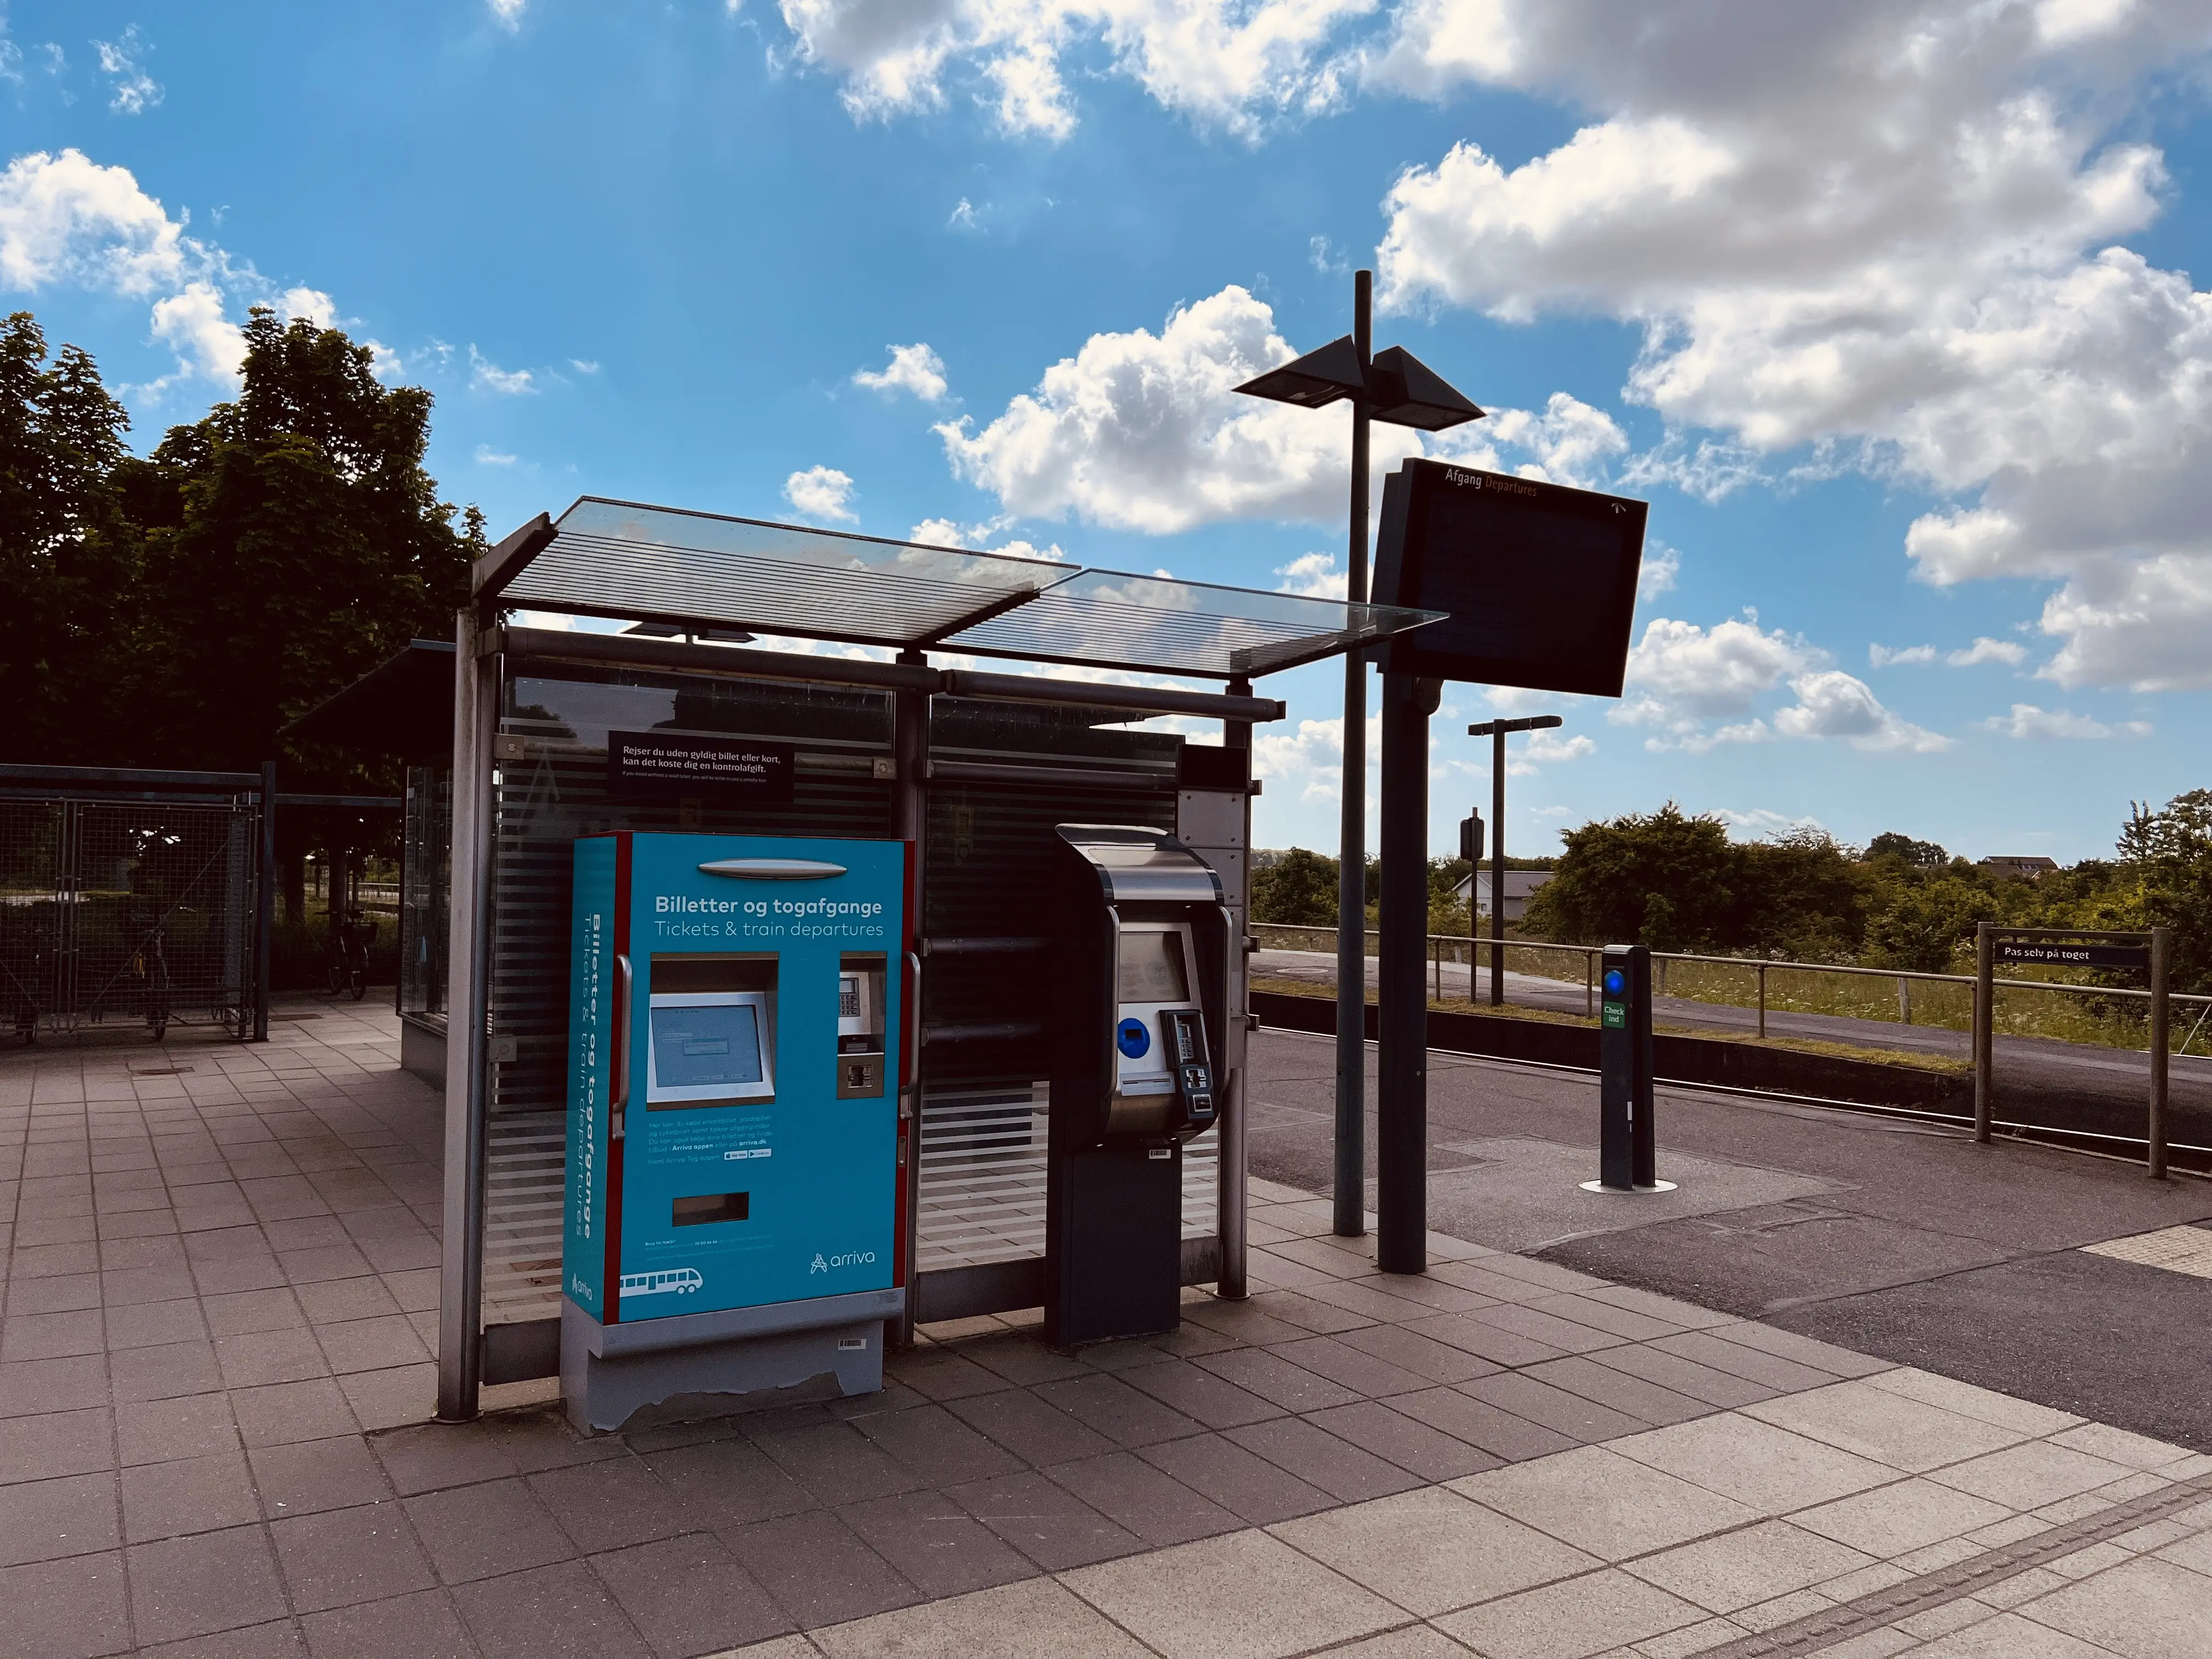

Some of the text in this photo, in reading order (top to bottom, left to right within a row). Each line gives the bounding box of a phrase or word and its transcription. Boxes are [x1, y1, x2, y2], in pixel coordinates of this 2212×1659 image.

[1445, 468, 1537, 496] Afgang Departures
[623, 746, 781, 764] Rejser du uden gyldig billet eller kort,
[623, 757, 639, 765] kan
[641, 758, 656, 766] det
[658, 759, 682, 768] koste
[684, 760, 698, 770] dig
[713, 762, 766, 774] kontrolafgift.
[656, 896, 882, 918] Billetter og togafgange
[654, 921, 883, 939] Tickets & train departures
[583, 913, 591, 998] Tickets
[2005, 947, 2089, 960] Pas selv på toget
[582, 1007, 589, 1022] &
[1604, 1006, 1624, 1015] Check
[1608, 1014, 1620, 1023] ind
[584, 914, 600, 1239] Billetter og togafgange
[577, 1098, 586, 1236] departures
[830, 1250, 875, 1267] arriva
